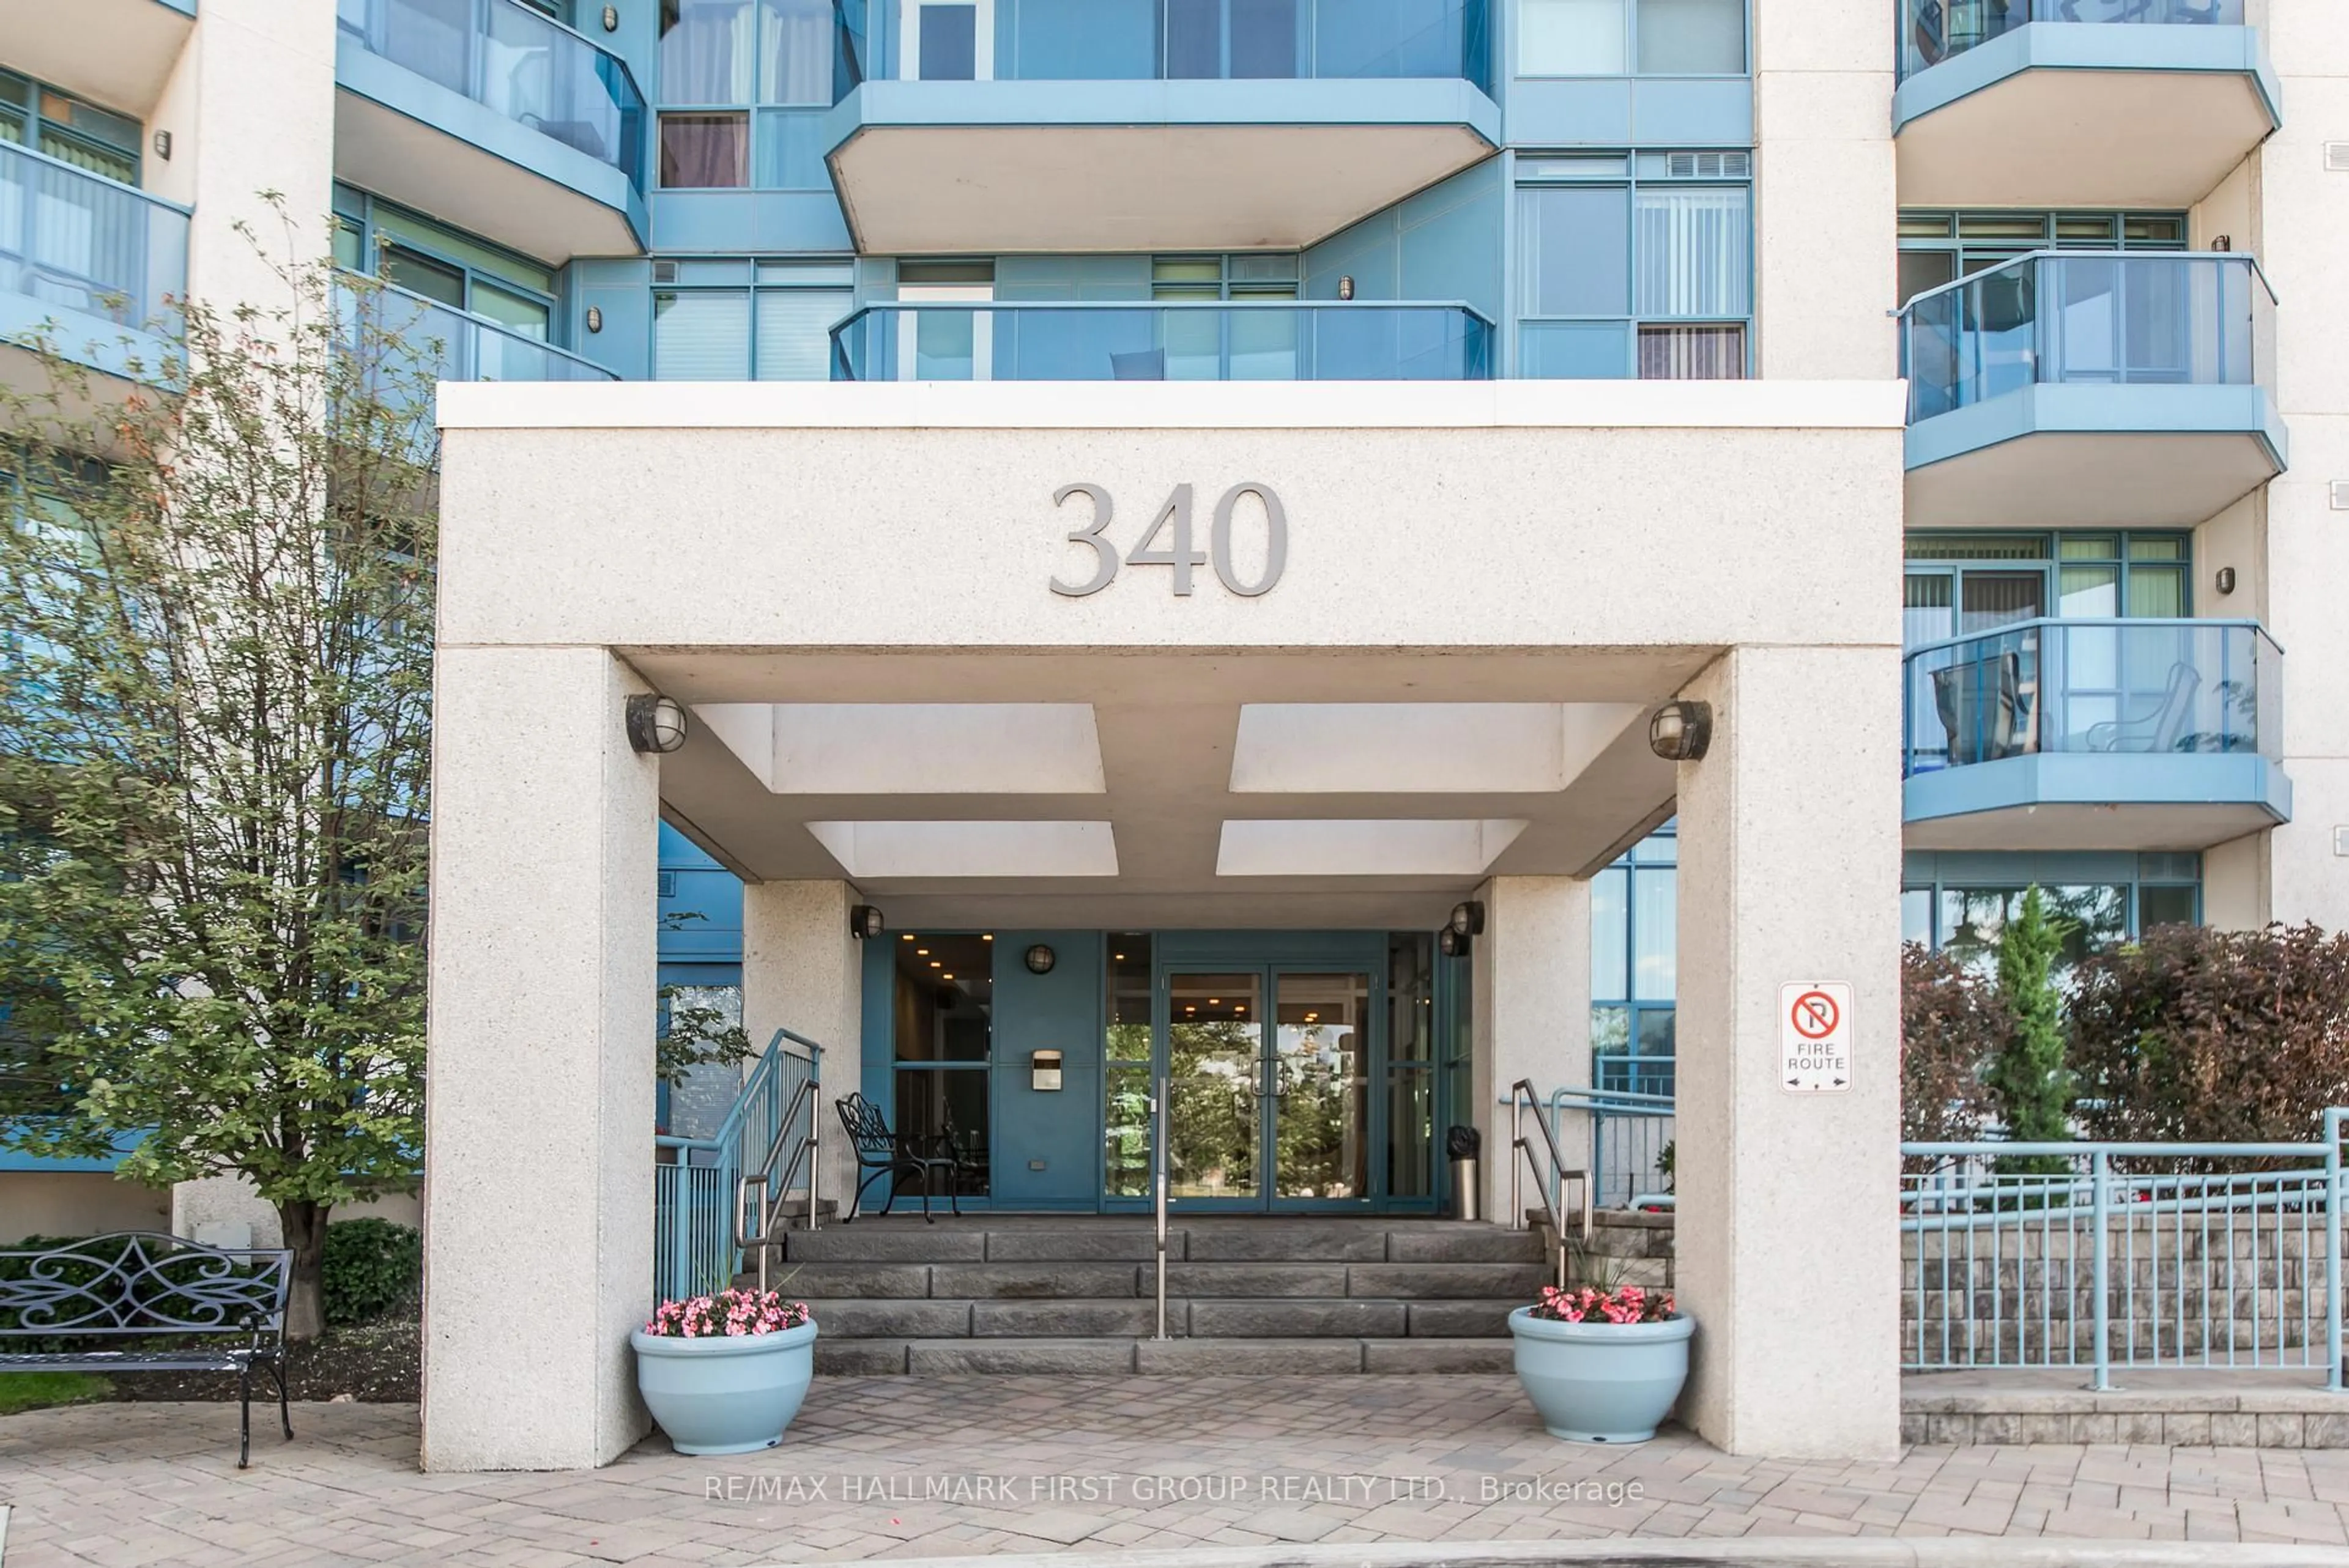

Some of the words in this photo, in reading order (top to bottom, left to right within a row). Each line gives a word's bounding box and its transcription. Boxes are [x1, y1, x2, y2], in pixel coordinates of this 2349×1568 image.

[1049, 482, 1288, 597] 340
[1797, 1043, 1835, 1055] FIRE
[1788, 1058, 1844, 1069] ROUTE
